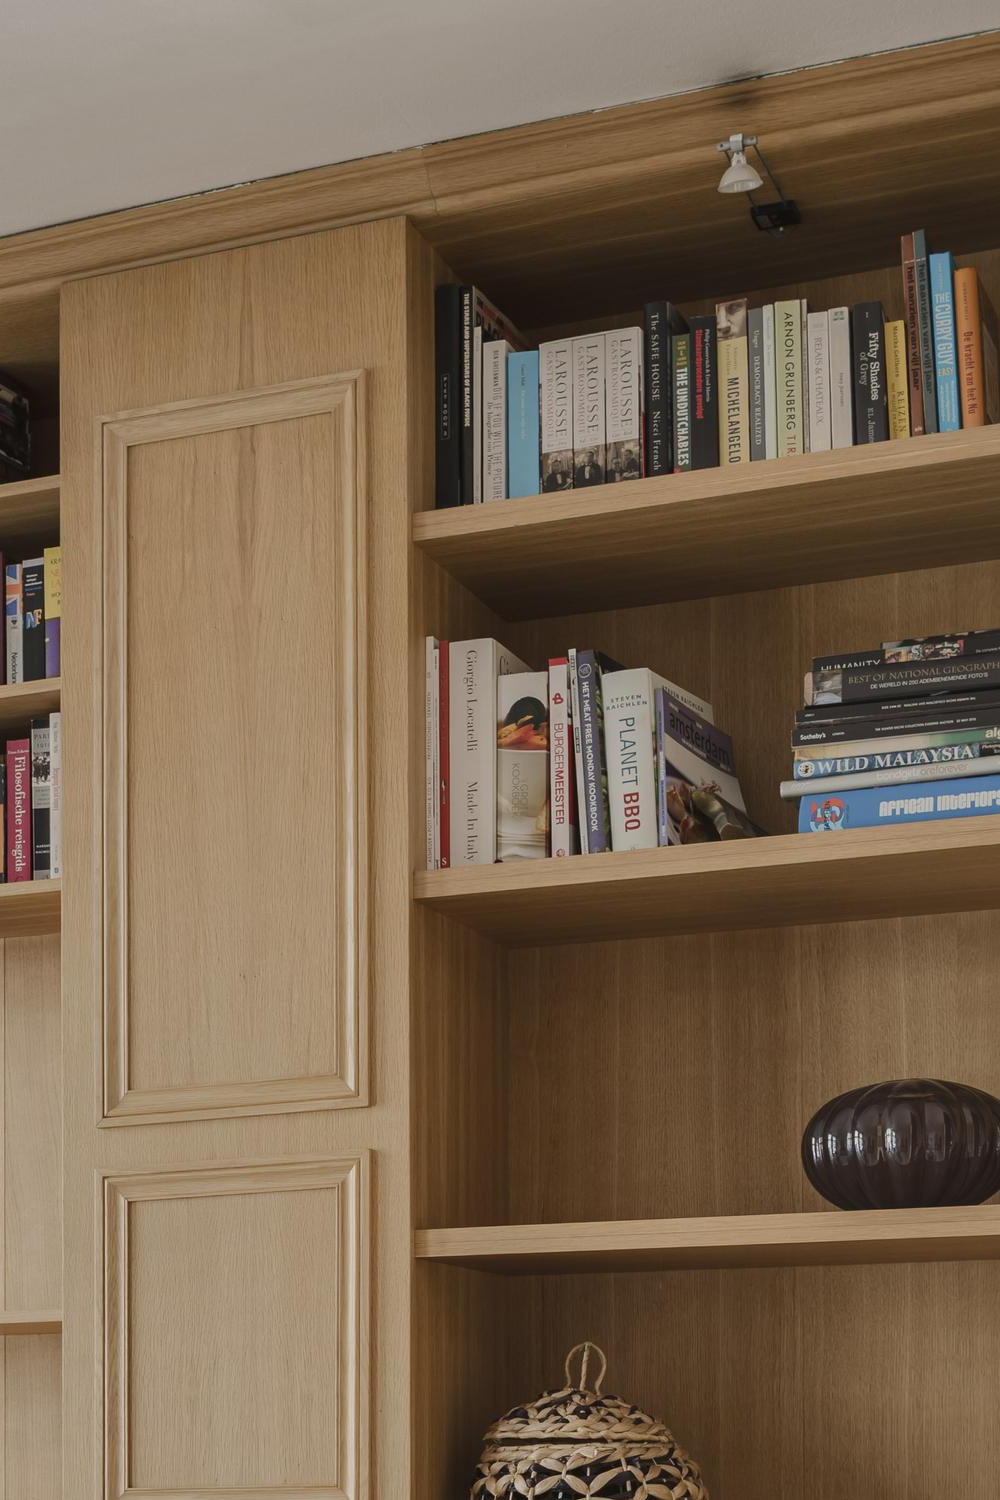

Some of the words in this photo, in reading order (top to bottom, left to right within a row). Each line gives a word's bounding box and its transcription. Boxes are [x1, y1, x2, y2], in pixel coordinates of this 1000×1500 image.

[906, 266, 915, 284] het
[918, 264, 927, 282] het
[908, 286, 916, 328] aanzien
[920, 284, 930, 329] aanzien
[934, 291, 951, 304] THE
[650, 312, 660, 326] The
[935, 304, 950, 340] CURRY
[650, 334, 660, 360] SAFE
[784, 312, 795, 358] ARNON
[868, 332, 880, 360] Fifty
[963, 331, 974, 342] De
[814, 336, 824, 366] RELAIS
[859, 352, 868, 361] of
[910, 352, 920, 366] vijf
[924, 354, 932, 369] vijf
[938, 343, 953, 366] GUY
[964, 344, 976, 370] kracht
[619, 338, 633, 428] LAROUSSE
[651, 364, 661, 401] HOUSE
[676, 368, 688, 386] THE
[754, 355, 762, 407] DEMOCRACY
[858, 364, 869, 386] Grey
[870, 362, 881, 400] Shades
[912, 368, 920, 390] jaar
[924, 370, 933, 394] jaar
[966, 372, 975, 386] van
[493, 388, 502, 400] DIG
[554, 350, 568, 438] LAROUSSE
[586, 345, 600, 433] LAROUSSE
[784, 362, 796, 430] GRUNBERG
[968, 388, 977, 401] het
[494, 414, 502, 428] YOU
[727, 377, 742, 464] MICHELANGELO
[897, 391, 907, 432] REIZEN
[968, 404, 978, 414] Nu
[651, 411, 662, 436] Nicci
[676, 388, 689, 466] UNDUTCHABLES
[494, 431, 502, 448] WILL
[786, 434, 797, 456] TIR
[494, 452, 502, 464] THE
[652, 440, 662, 471] French
[494, 468, 502, 500] PICTURE
[463, 650, 479, 696] Giorgio
[848, 672, 869, 684] BEST
[872, 672, 886, 682] OF
[890, 666, 941, 680] NATIONAL
[582, 681, 590, 698] HET
[610, 694, 642, 703] STEVEN
[583, 700, 592, 722] MEAT
[606, 700, 648, 711] RAICHLEN
[466, 700, 480, 752] Locatelli
[584, 724, 592, 744] FREE
[670, 712, 730, 766] amsterdam
[586, 746, 595, 781] MONDAY
[619, 717, 639, 786] PLANET
[818, 756, 868, 774] WILD
[874, 745, 973, 768] MALAYSIA
[554, 722, 566, 825] BURGERMEESTER
[14, 756, 26, 825] Filosofische
[466, 782, 479, 814] Made
[588, 783, 598, 832] KOOKBOOK
[622, 792, 641, 832] BBQ
[878, 796, 934, 817] african
[466, 819, 479, 832] In
[12, 829, 26, 872] reisgids
[462, 835, 480, 862] Italy
